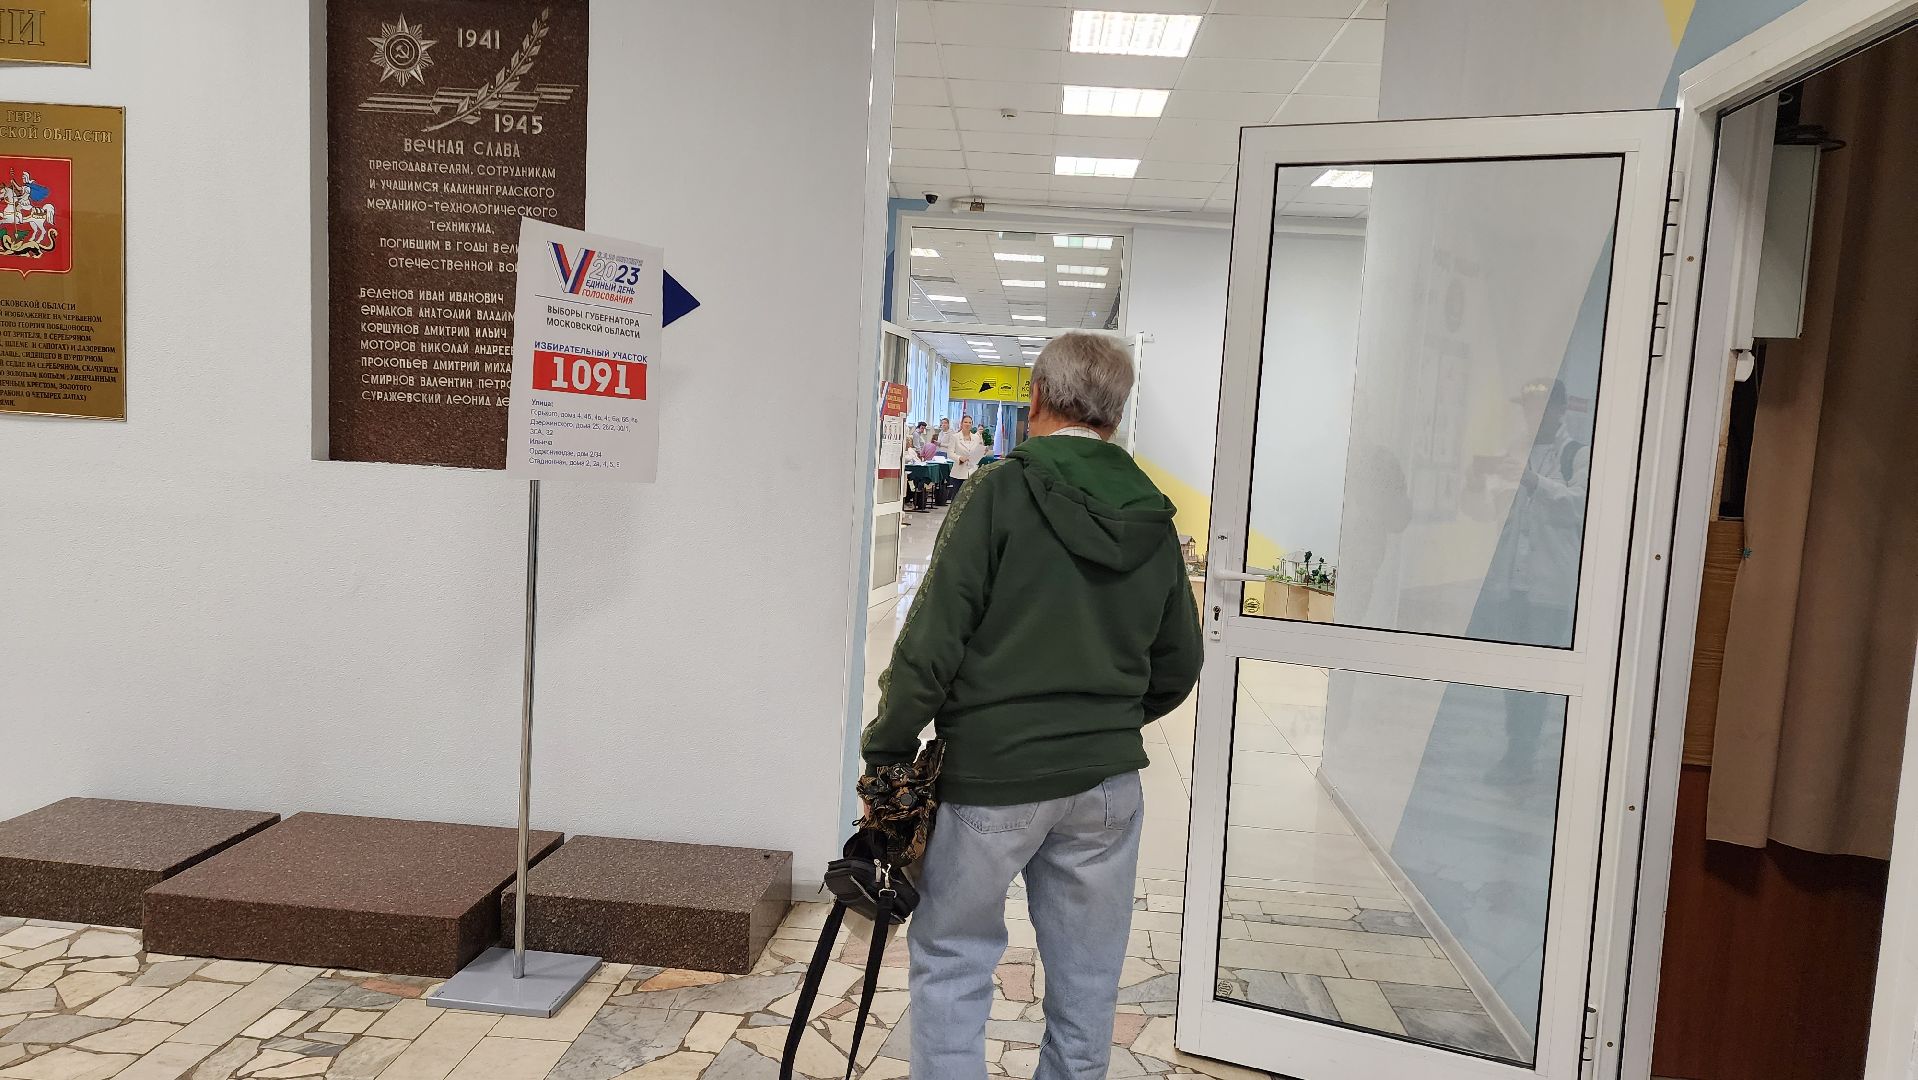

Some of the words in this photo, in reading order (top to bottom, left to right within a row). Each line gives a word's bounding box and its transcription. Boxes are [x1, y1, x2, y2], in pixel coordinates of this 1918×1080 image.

[457, 27, 500, 50] 1941
[7, 110, 42, 123] ГЕРБ
[494, 113, 544, 135] 1945
[43, 128, 113, 143] ОБЛАСТИ
[403, 138, 464, 155] ВЕЧНАЯ
[473, 141, 521, 158] СЛАВА
[369, 159, 474, 176] ПРЕПОДАВАТЕЛЯМ,
[477, 164, 556, 179] СОТРУДНИКАМ
[369, 180, 376, 190] И
[443, 183, 555, 199] КАЛИНИНГРАДСКОГО
[366, 198, 558, 218] МЕХАНИКО-ТЕХНОЛОГИЧЕСКОГО
[379, 237, 440, 251] ПОГИБШИМ
[444, 241, 451, 251] В
[456, 241, 488, 253] ГОДЫ
[388, 257, 493, 272] ОТЕЧЕСТВЕННОЙ
[589, 258, 641, 286] 2023
[360, 287, 414, 300] БЕЛЕНОВ
[419, 290, 445, 301] ИВАН
[449, 291, 504, 304] ИВАНОВИЧ
[586, 279, 617, 292] ЕДИНЫЙ
[617, 284, 636, 295] ДЕНЬ
[581, 288, 634, 305] ГОЛОСОВАНИЯ
[41, 302, 76, 311] ОБЛАСТИ
[360, 304, 413, 317] ЕРМАКОВ
[418, 307, 471, 320] АНАТОЛИЙ
[547, 304, 583, 319] ВЫБОРЫ
[585, 311, 640, 328] ГУБЕРНАТОРА
[360, 322, 419, 335] КОРШУНОВ
[423, 324, 470, 337] ДМИТРИЙ
[475, 327, 507, 339] ИЛЬИЧ
[546, 317, 603, 333] МОСКОВСКОЙ
[604, 327, 641, 339] ОБЛАСТИ
[360, 339, 416, 352] МОТОРОВ
[421, 341, 469, 354] НИКОЛАЙ
[534, 340, 610, 358] ИЗБИРАТЕЛЬНЫЙ
[612, 351, 648, 363] УЧАСТОК
[361, 356, 428, 370] ПРОКОПЬЕВ
[433, 359, 480, 372] ДМИТРИЙ
[484, 362, 512, 374] МИХА
[361, 373, 415, 387] СМИРНОВ
[420, 376, 473, 389] ВАЛЕНТИН
[551, 356, 631, 396] 1091
[361, 390, 441, 404] СУРАЖЕВСКИЙ
[446, 394, 491, 407] ЛЕОНИД
